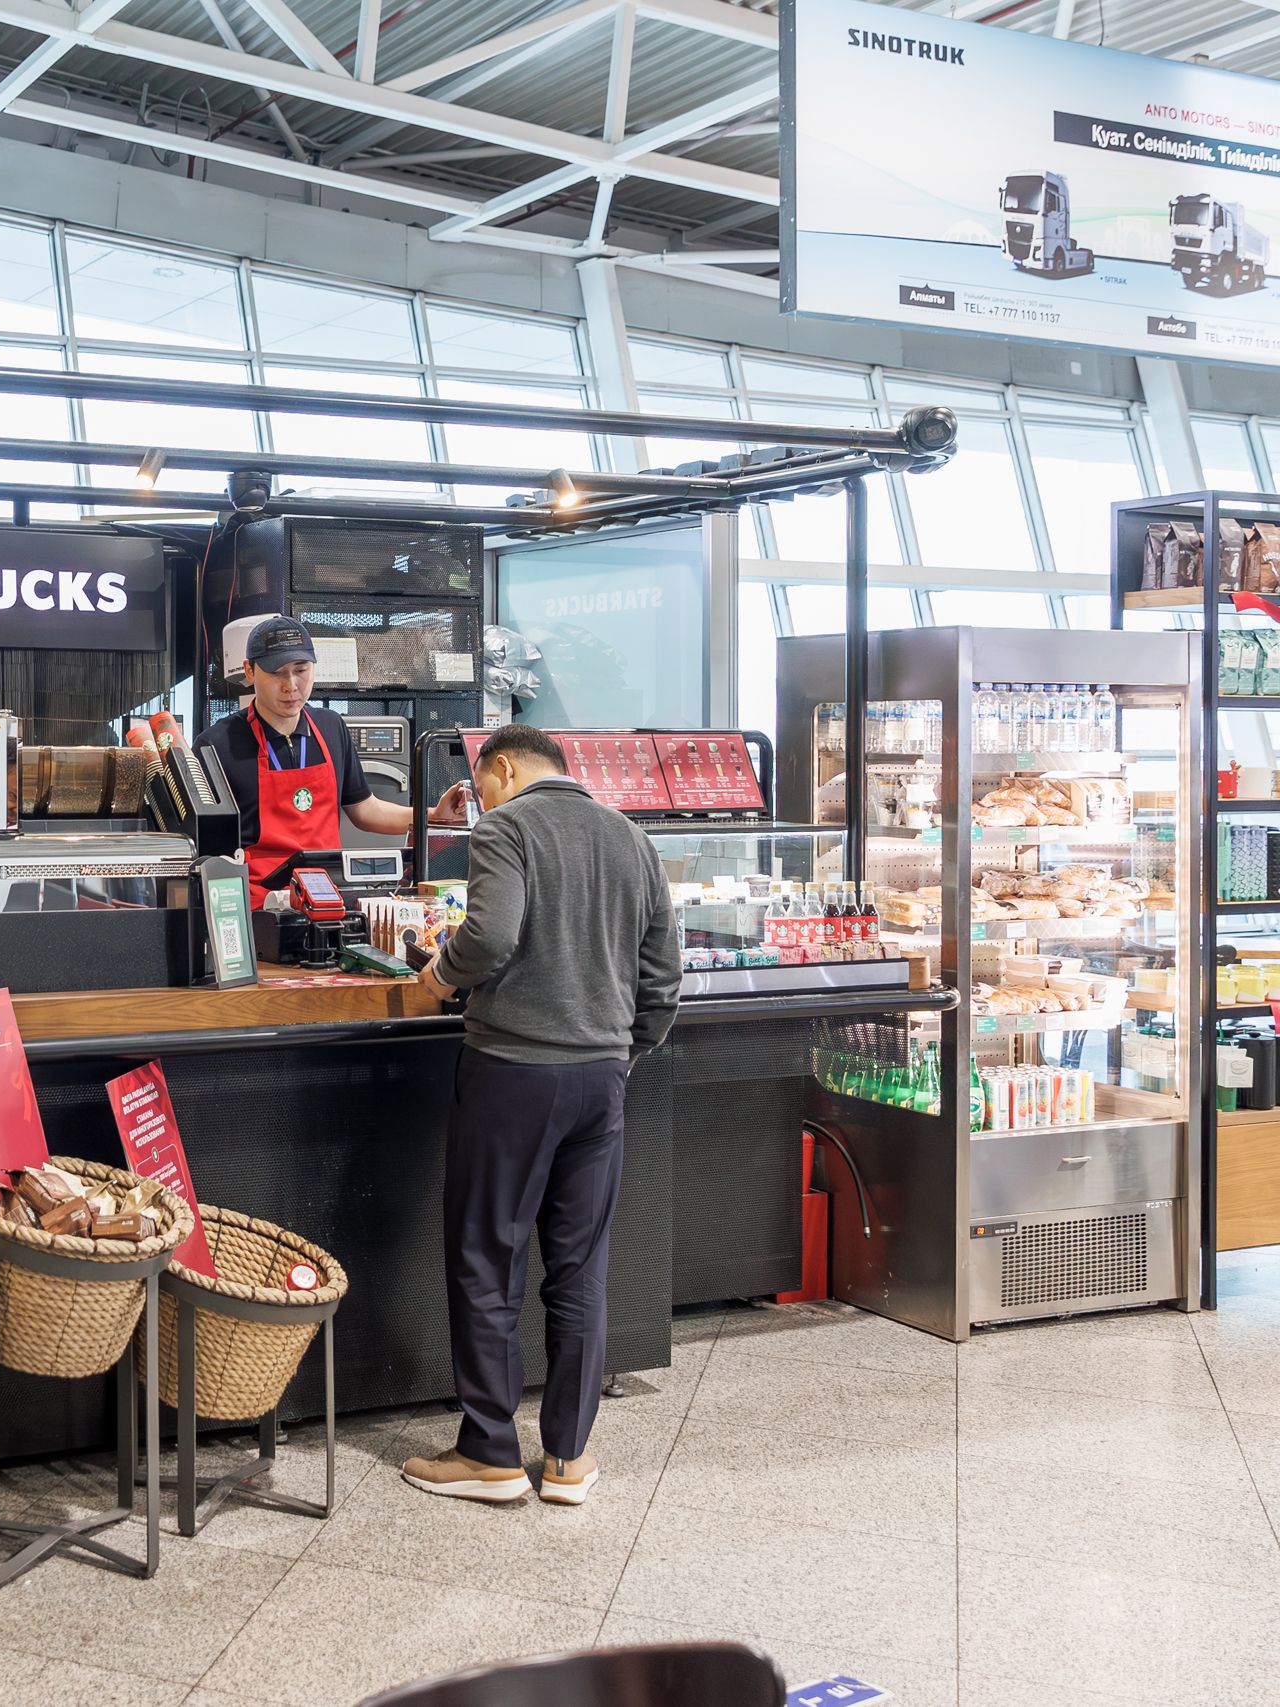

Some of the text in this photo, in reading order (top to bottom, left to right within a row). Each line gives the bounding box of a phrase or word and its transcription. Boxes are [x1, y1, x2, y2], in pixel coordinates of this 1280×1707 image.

[848, 28, 965, 65] SINOTRUK
[1145, 103, 1177, 119] ANTO
[1181, 109, 1231, 129] MOTORS
[910, 290, 946, 305] Алматы
[964, 302, 1061, 324] TEL: +7 777 110 1137
